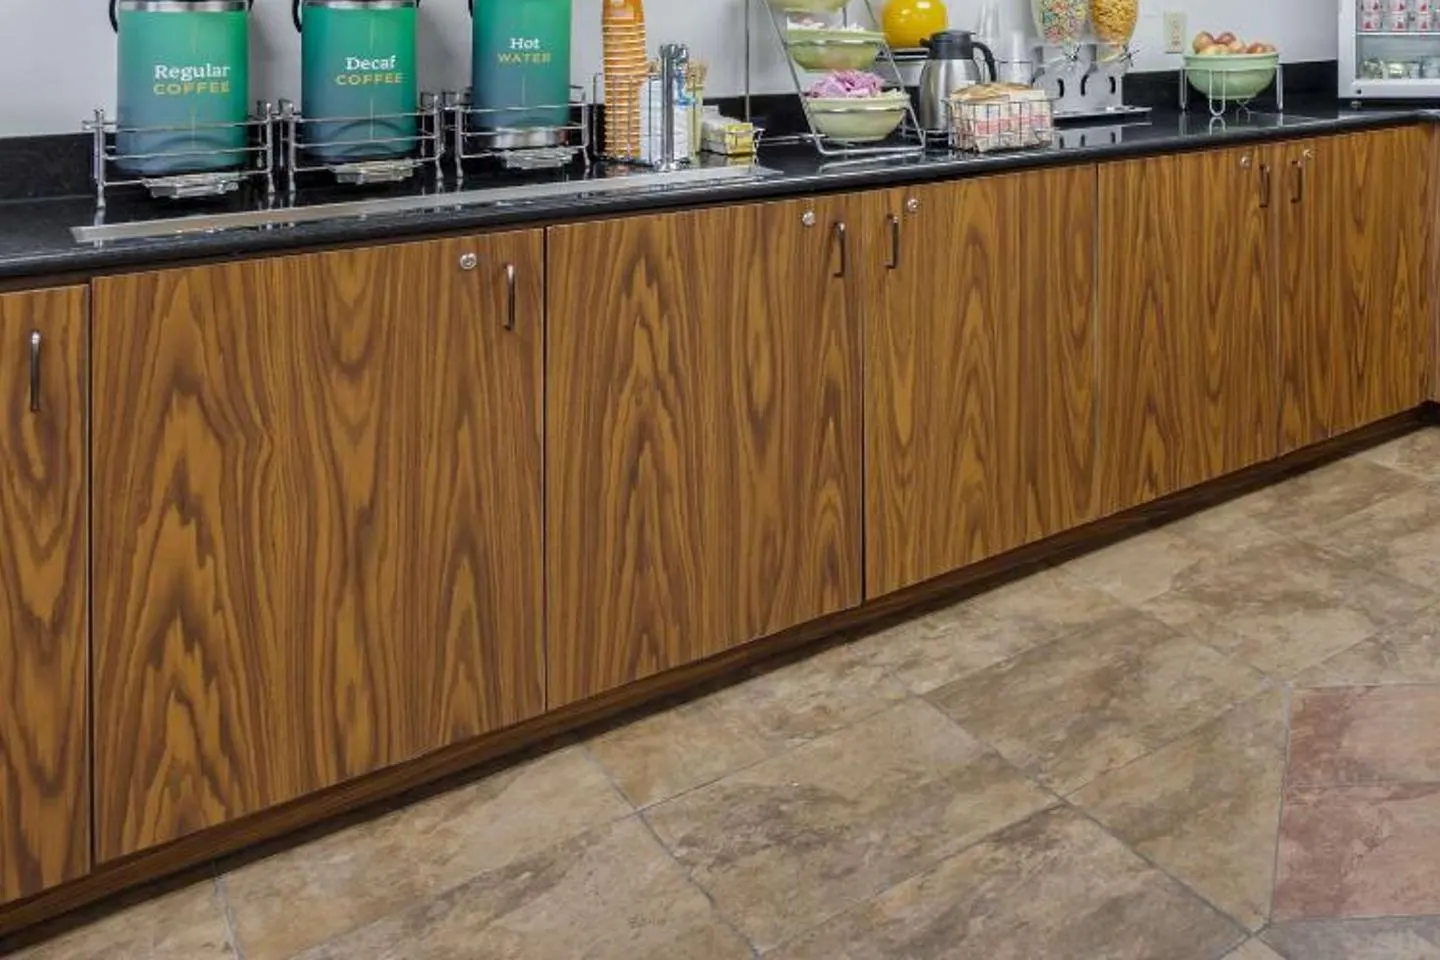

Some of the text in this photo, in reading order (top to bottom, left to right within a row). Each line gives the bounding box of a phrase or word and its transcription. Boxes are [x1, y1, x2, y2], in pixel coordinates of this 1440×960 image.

[509, 37, 541, 50] Hot
[345, 54, 397, 71] Decaf
[497, 52, 551, 64] WATER
[154, 62, 231, 81] Regular
[336, 72, 404, 86] COFFEE
[153, 80, 232, 96] COFFEE
